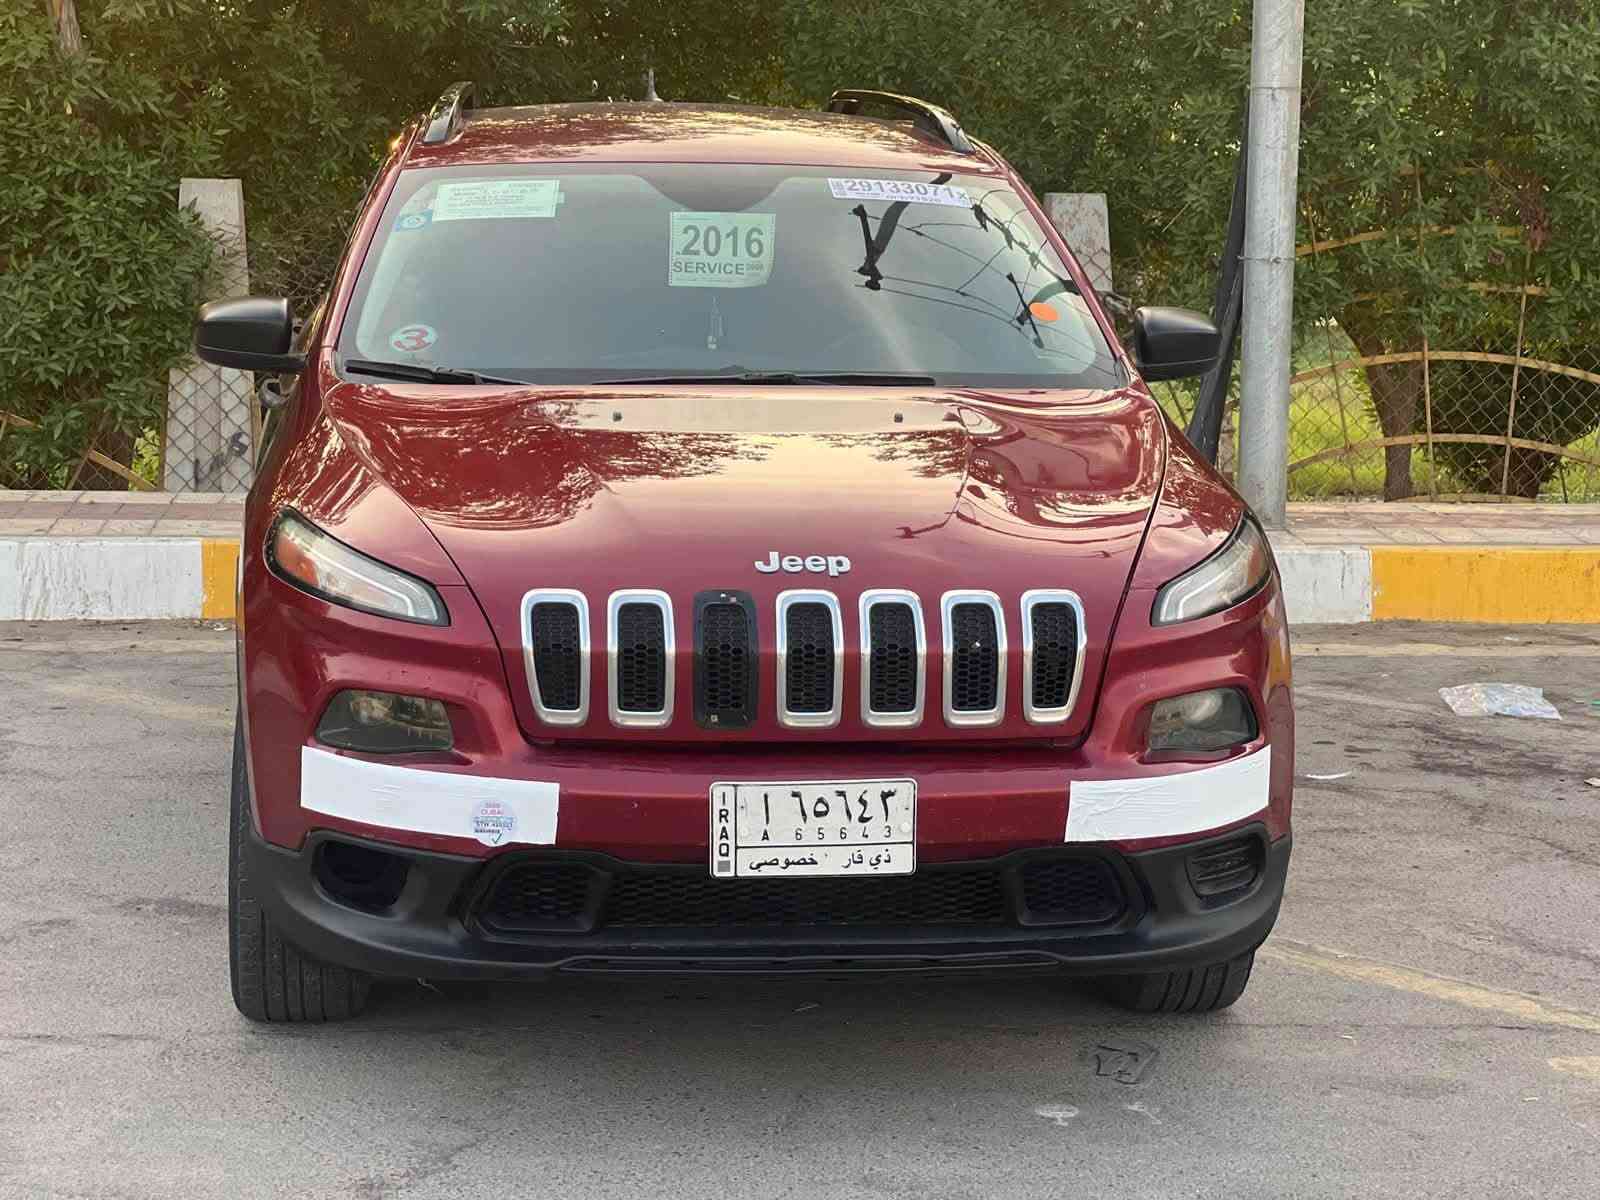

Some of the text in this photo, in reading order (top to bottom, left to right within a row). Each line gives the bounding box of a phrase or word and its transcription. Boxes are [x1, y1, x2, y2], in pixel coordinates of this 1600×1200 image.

[843, 179, 955, 200] 29133071
[679, 224, 764, 258] 2016
[671, 260, 745, 276] SERVICE
[753, 550, 852, 577] Jeep
[717, 791, 730, 858] IRAQ
[761, 824, 893, 842] A 65643
[749, 852, 819, 873] خصوصي
[868, 847, 892, 870] ذي
